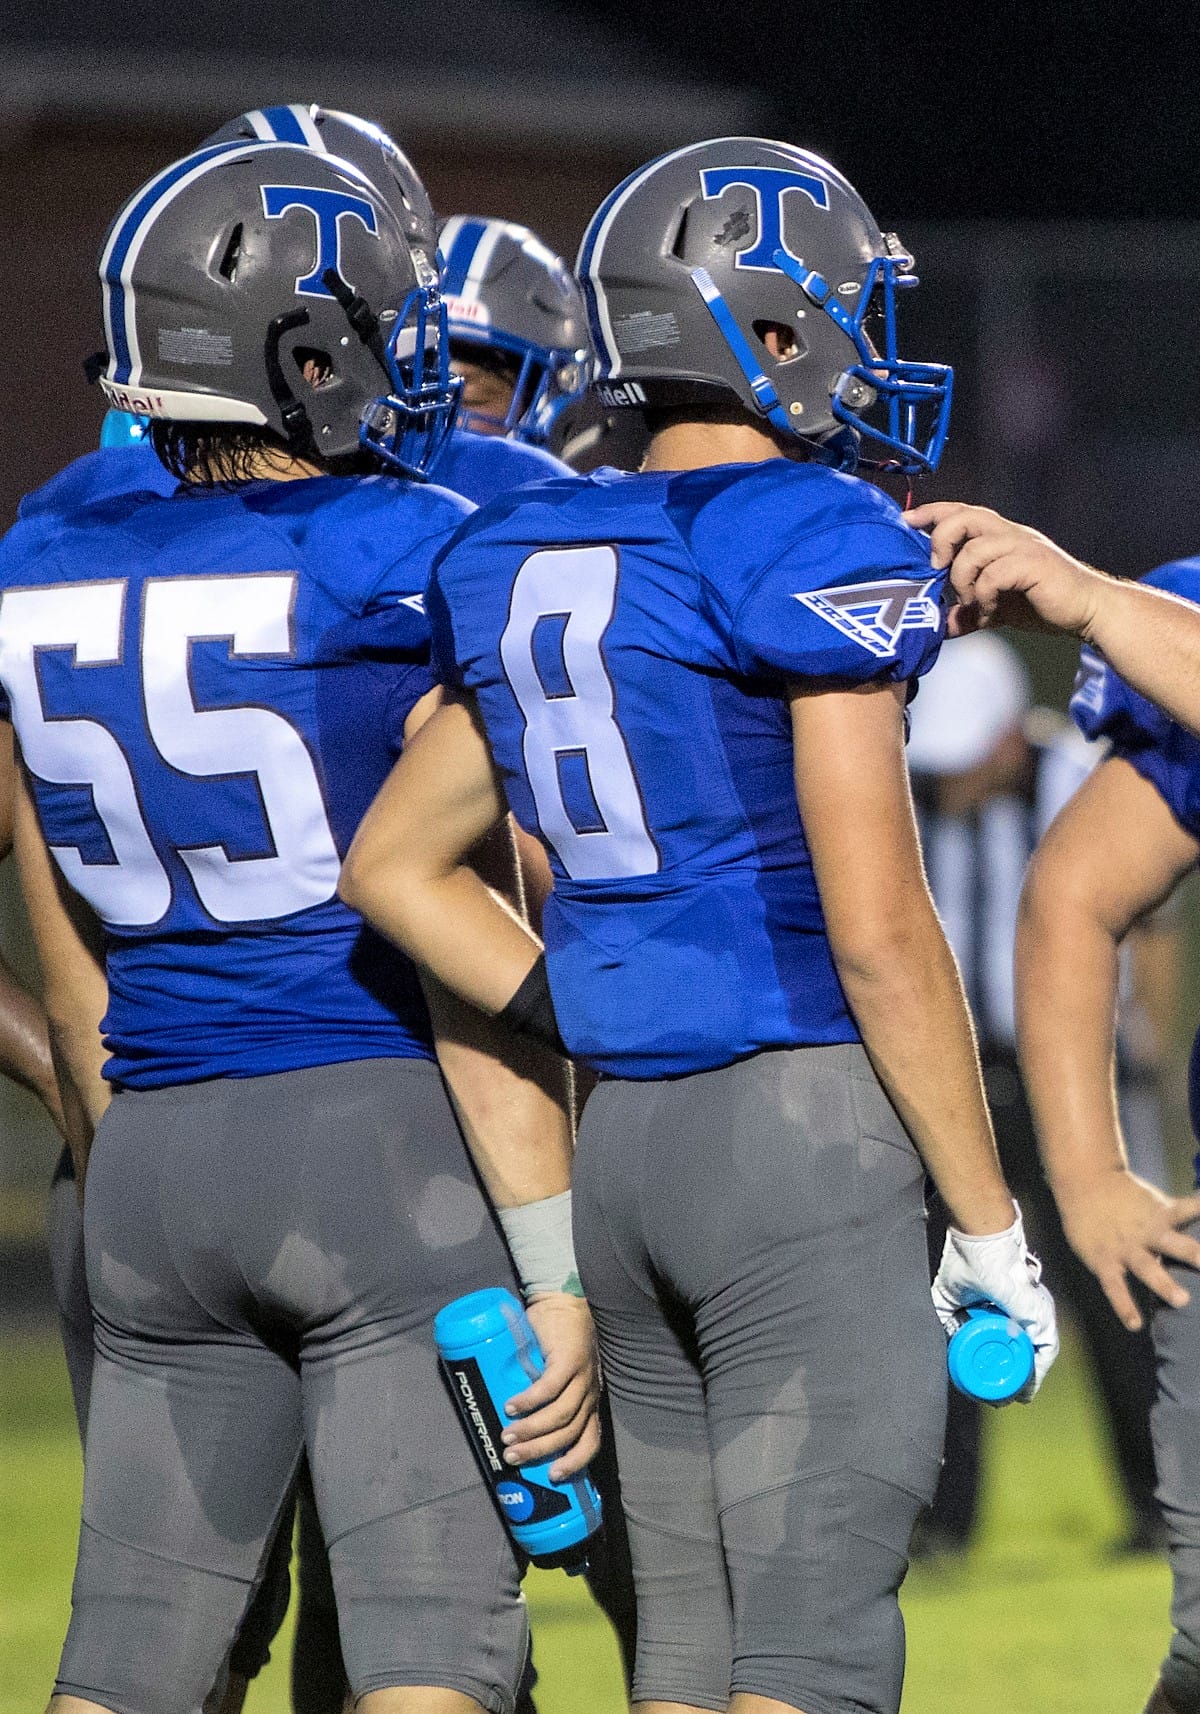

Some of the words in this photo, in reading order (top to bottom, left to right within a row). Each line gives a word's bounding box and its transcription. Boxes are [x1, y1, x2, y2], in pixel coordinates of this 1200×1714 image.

[259, 184, 379, 299] T
[699, 165, 831, 272] T
[0, 571, 341, 926] 55
[500, 544, 663, 881] 8
[455, 1371, 503, 1472] POWERADE
